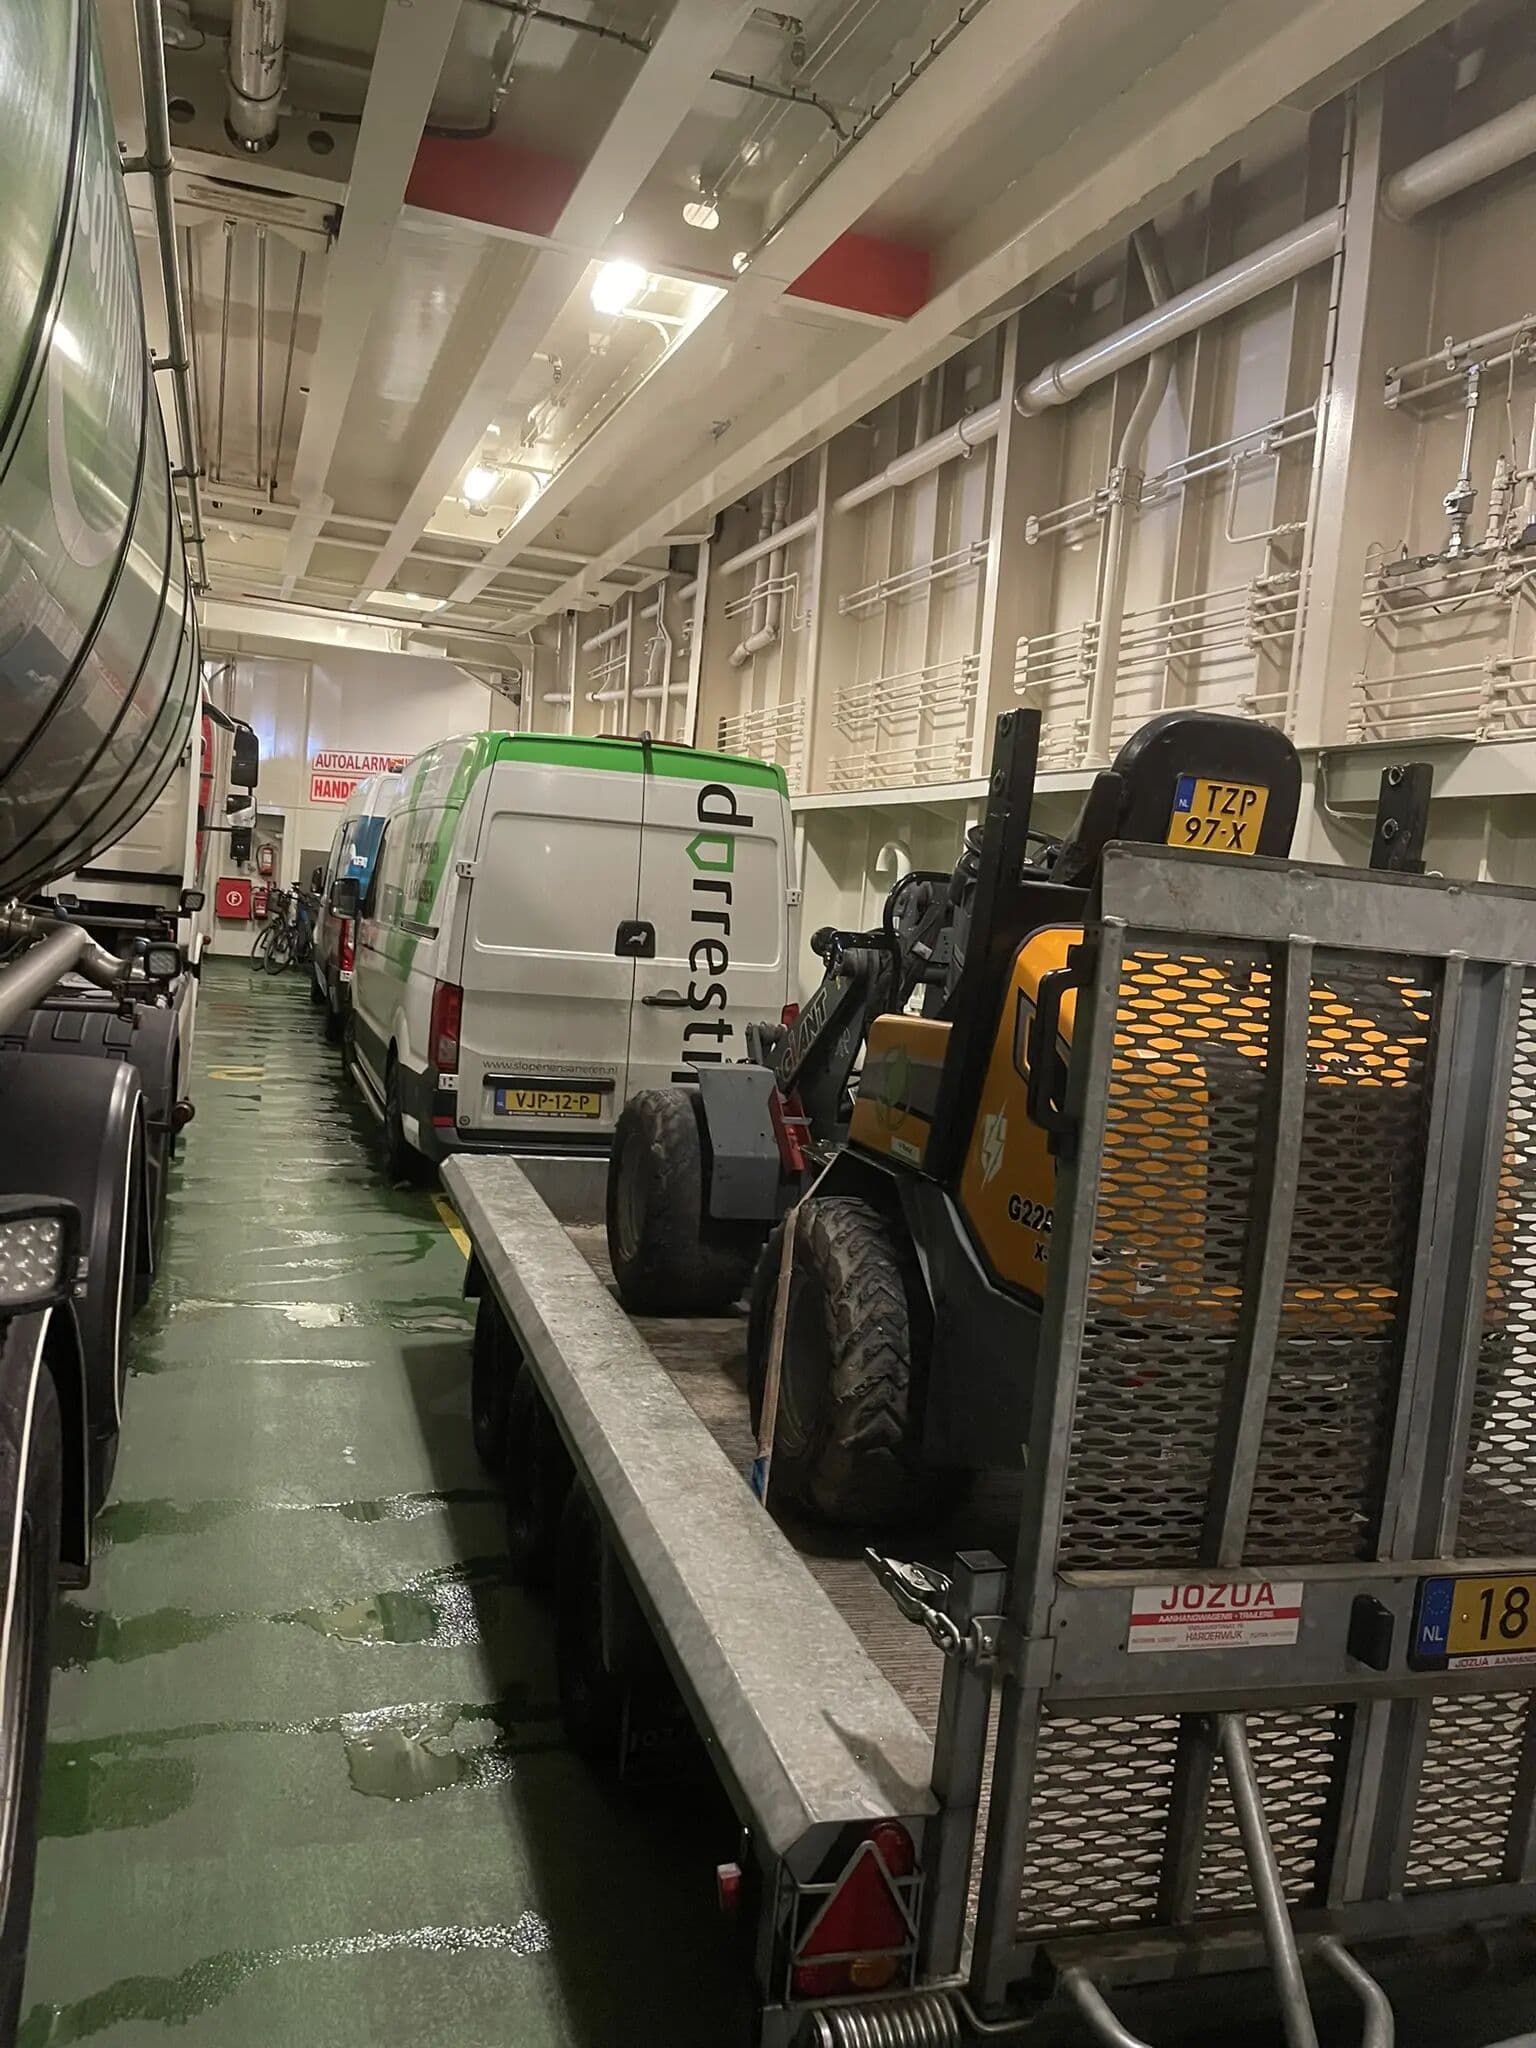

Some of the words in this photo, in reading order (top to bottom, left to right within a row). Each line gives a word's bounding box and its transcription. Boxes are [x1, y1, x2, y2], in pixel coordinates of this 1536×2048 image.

[1207, 784, 1257, 816] TZP
[1185, 817, 1247, 849] 97-X
[515, 1092, 590, 1110] VJP-12-P
[1160, 1582, 1275, 1610] JOZUA
[1479, 1586, 1531, 1640] 18
[1185, 1630, 1243, 1641] HARDERWIJK
[1422, 1625, 1444, 1642] NL
